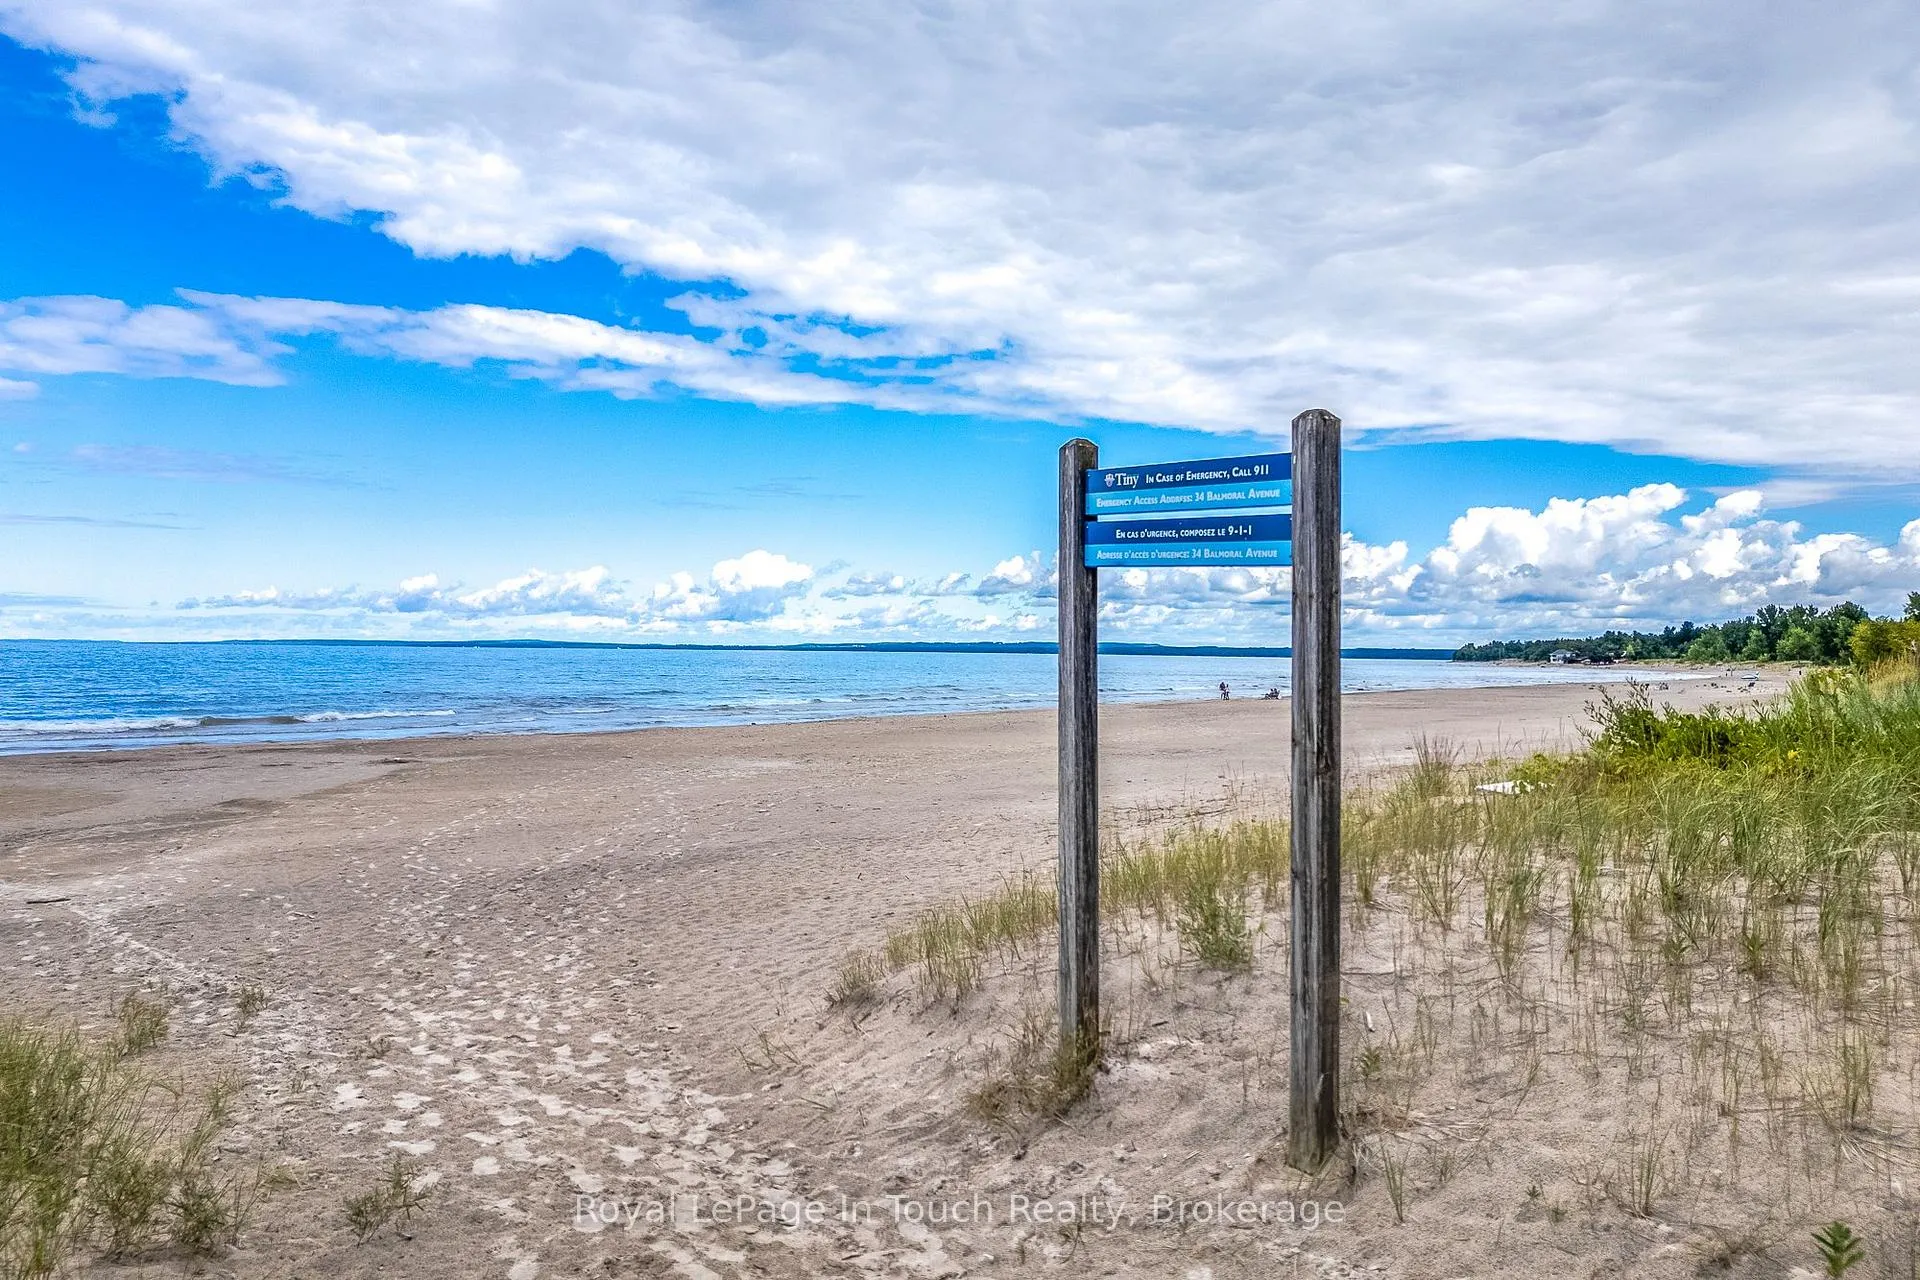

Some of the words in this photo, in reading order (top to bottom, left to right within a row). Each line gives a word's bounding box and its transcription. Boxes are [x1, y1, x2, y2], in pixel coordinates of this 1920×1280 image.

[1115, 473, 1139, 488] Tiny
[1254, 464, 1269, 475] 911
[1194, 492, 1205, 502] 34
[1180, 528, 1215, 537] COMPOSEZ
[1217, 528, 1226, 536] LE
[1228, 525, 1252, 536] 9-1-1
[1191, 548, 1202, 558] 34
